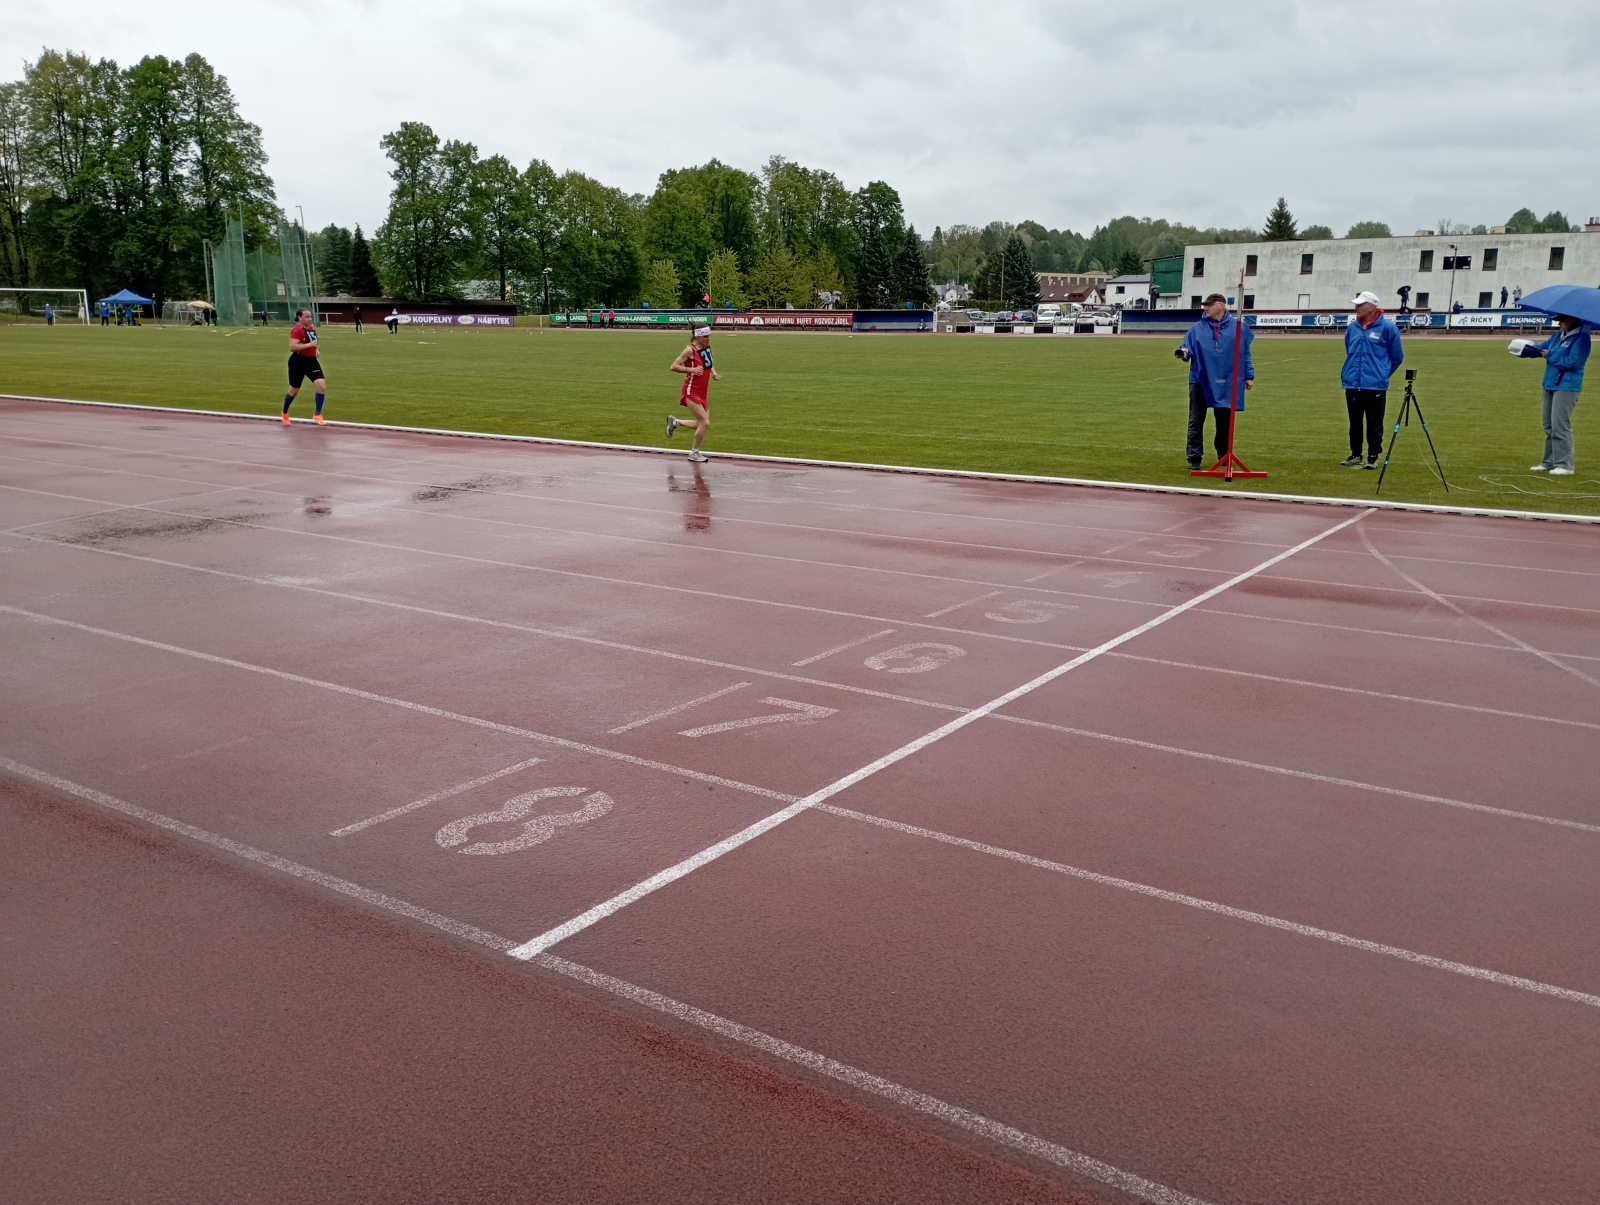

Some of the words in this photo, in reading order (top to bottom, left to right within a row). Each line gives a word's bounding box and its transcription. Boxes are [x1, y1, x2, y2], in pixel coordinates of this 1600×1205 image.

[412, 315, 453, 324] KOUPELNY
[477, 315, 510, 325] NÁBYTEK
[716, 316, 734, 324] JÍDELNA
[764, 316, 780, 325] DENNÍ
[780, 317, 795, 325] MENU
[796, 317, 812, 325] BUFET
[814, 317, 834, 325] ROZVOZ
[1470, 315, 1494, 323] ŘÍČKY
[985, 599, 1080, 624] 5
[864, 642, 967, 674] 6
[677, 696, 840, 738] 7
[435, 786, 614, 856] 8
